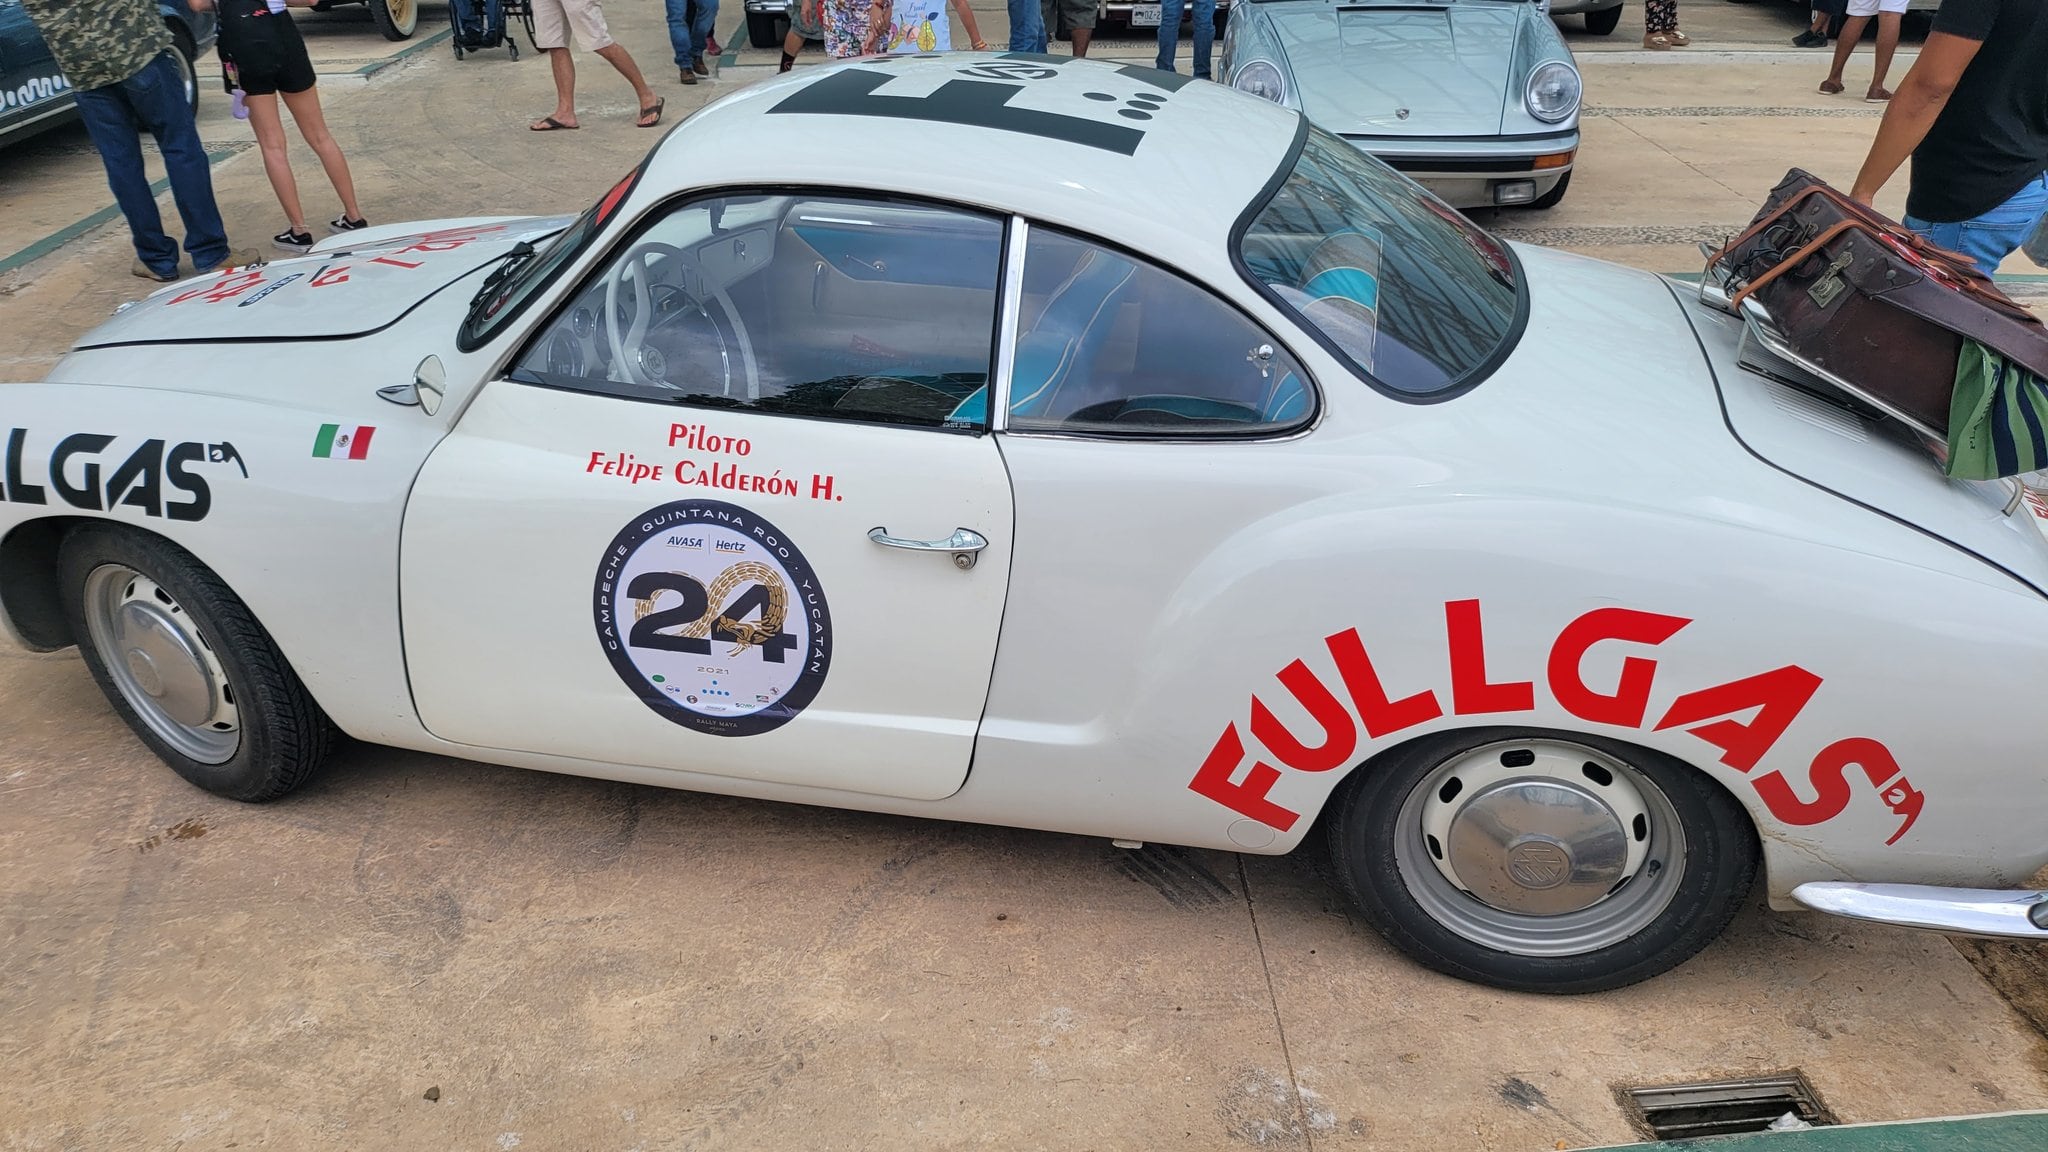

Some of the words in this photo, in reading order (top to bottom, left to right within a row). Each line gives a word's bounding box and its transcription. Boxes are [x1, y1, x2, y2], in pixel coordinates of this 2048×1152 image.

[0, 428, 212, 522] LGAS
[668, 423, 752, 457] Piloto
[586, 451, 663, 485] Felipe
[675, 459, 798, 497] Calderón
[811, 474, 843, 502] H.
[715, 539, 746, 553] Hertz
[598, 545, 629, 651] CAMPECHE
[641, 508, 745, 533] QUINTANA
[753, 526, 790, 560] ROO
[802, 579, 826, 673] YUCATÁN
[626, 571, 798, 664] 24
[696, 666, 731, 676] 2021
[1188, 598, 1900, 831] FULLGAS
